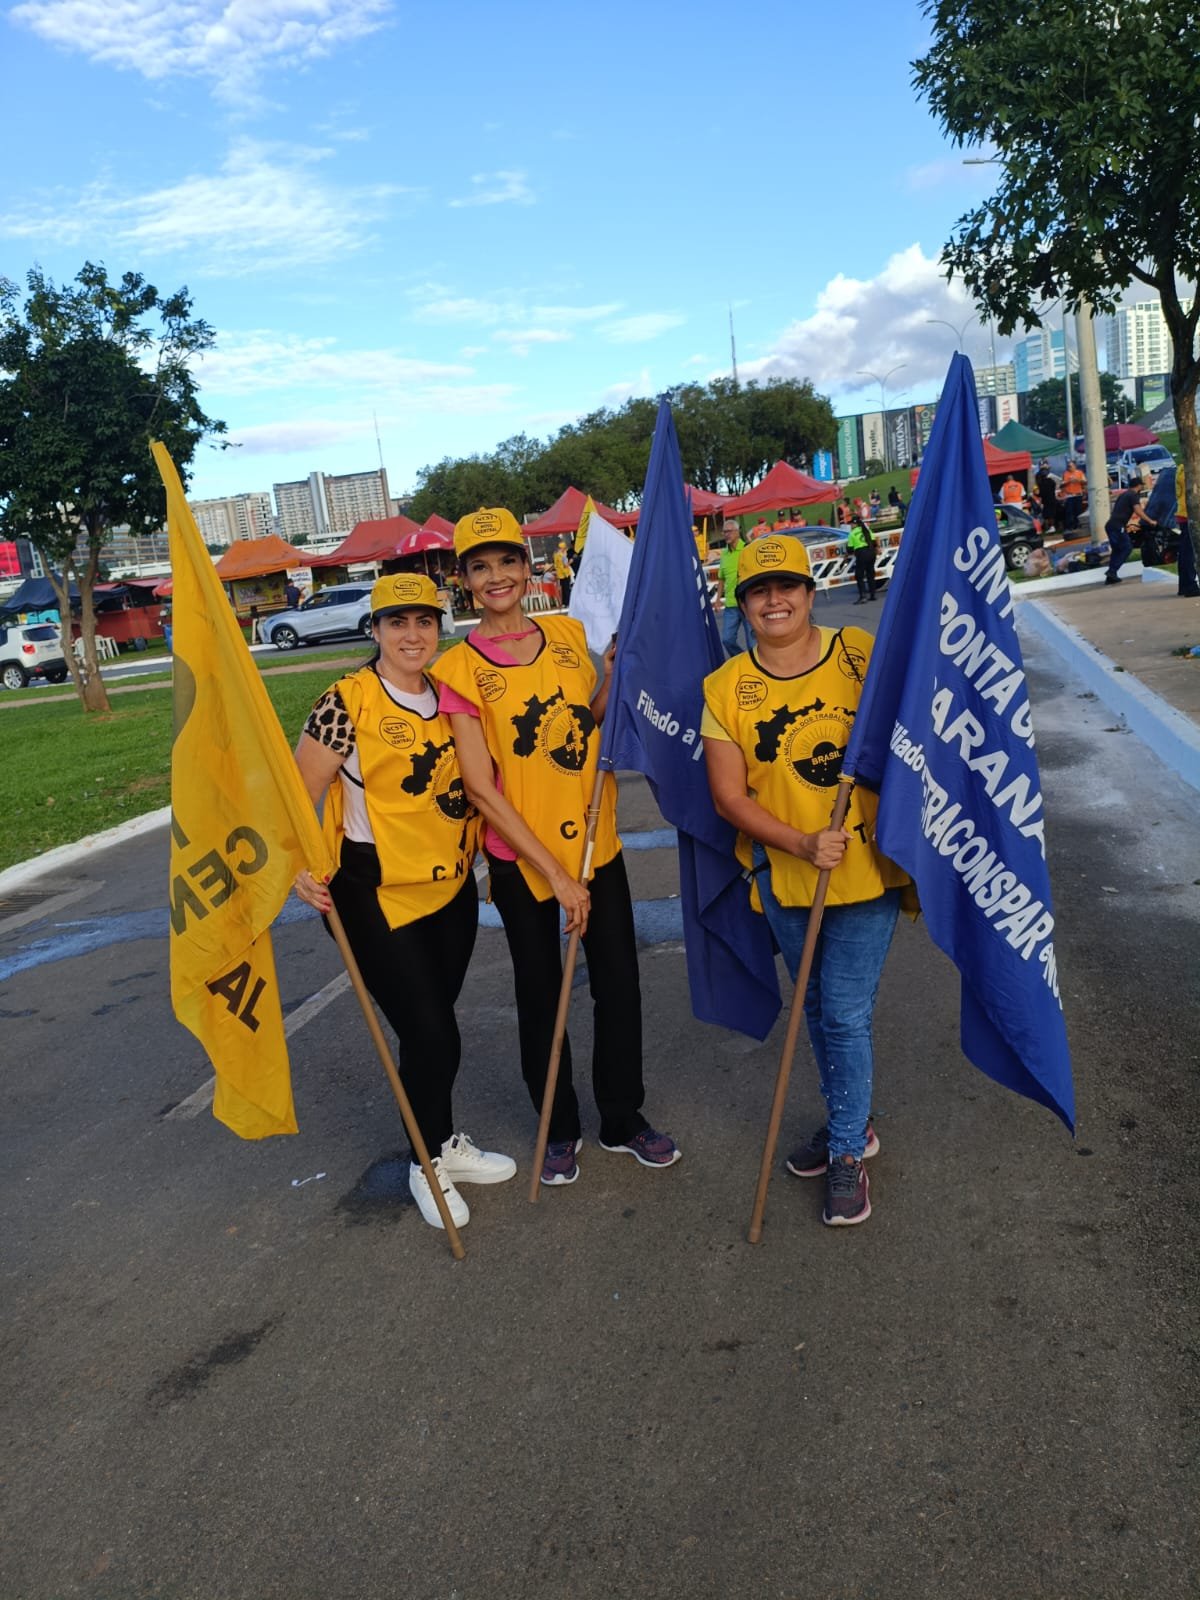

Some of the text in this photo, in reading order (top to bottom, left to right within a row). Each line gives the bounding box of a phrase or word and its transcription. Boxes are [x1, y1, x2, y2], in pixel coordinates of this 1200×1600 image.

[895, 415, 907, 467] SIMMONS
[636, 689, 696, 746] Filiado a
[784, 726, 800, 756] NACIONAL
[799, 716, 814, 727] DOS
[811, 751, 843, 766] BRASIL
[448, 790, 464, 800] BRA
